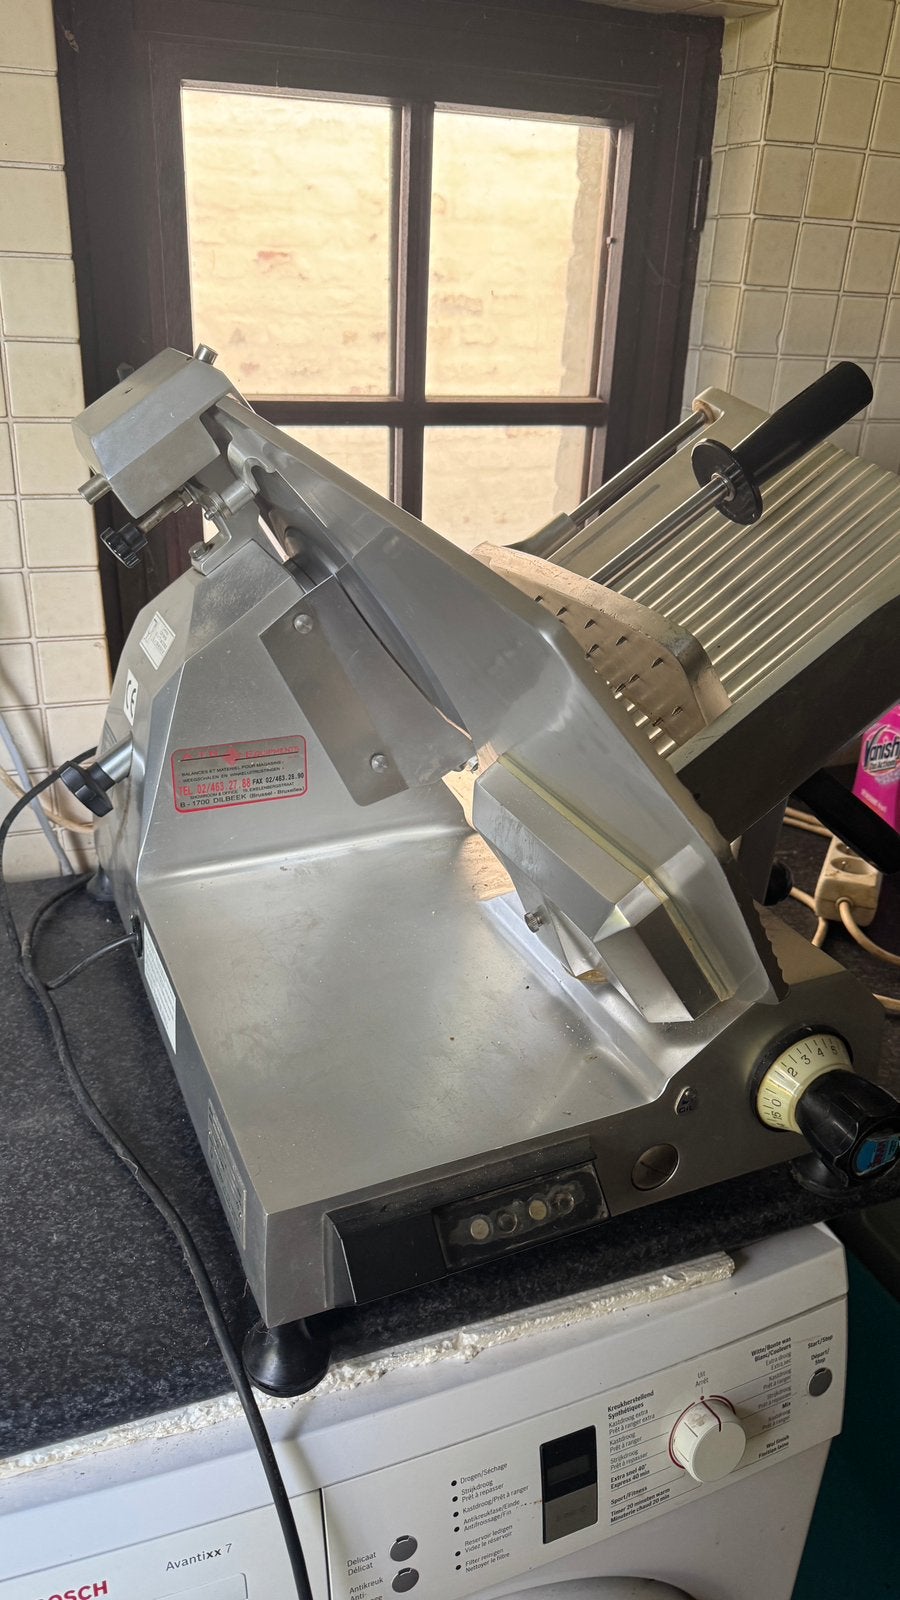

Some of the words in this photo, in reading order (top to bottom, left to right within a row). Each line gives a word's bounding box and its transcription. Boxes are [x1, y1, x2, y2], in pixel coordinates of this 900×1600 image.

[213, 794, 247, 804] DILBEEK
[771, 1098, 782, 1107] 0
[787, 1067, 798, 1078] 2
[800, 1055, 811, 1065] 3
[817, 1047, 825, 1057] 4
[751, 1341, 781, 1356] Witte/Bonte
[807, 1335, 833, 1349] Start/Stop
[754, 1344, 791, 1361] Blanc/Couleurs
[815, 1357, 826, 1365] Stop
[608, 1390, 654, 1412] Kreukherstellend
[608, 1402, 644, 1420] Synthétiques
[609, 1414, 635, 1428] Kastdroog
[635, 1409, 648, 1418] extra
[609, 1426, 620, 1434] Prêt
[625, 1418, 642, 1430] ranger
[642, 1414, 655, 1422] extra
[610, 1432, 636, 1446] Kastdroog
[610, 1444, 621, 1453] Prêt
[626, 1436, 642, 1447] ranger
[610, 1449, 639, 1464] Strijkdroog
[610, 1462, 622, 1470] Prêt
[626, 1452, 648, 1464] repasser
[460, 1463, 508, 1484] Drogen/Séchage
[611, 1473, 626, 1483] Extra
[626, 1468, 637, 1476] snel
[461, 1480, 493, 1496] Strijkdroog
[611, 1478, 631, 1489] Express
[462, 1494, 474, 1503] Prêt
[480, 1483, 504, 1496] repasser
[463, 1493, 505, 1514] Kastdroog/Prêt
[511, 1485, 529, 1496] ranger
[611, 1486, 647, 1505] Sport/Fitness
[611, 1507, 626, 1516] Timer
[634, 1496, 655, 1506] minuten
[656, 1488, 670, 1497] warm
[464, 1500, 520, 1525] Antikreukfase/Einde
[464, 1510, 512, 1532] Antifroissage/Fin
[611, 1509, 636, 1523] Minuterie
[636, 1501, 652, 1511] chaud
[465, 1532, 491, 1546] Reservoir
[492, 1525, 513, 1537] ledigen
[465, 1544, 480, 1553] Videz
[488, 1532, 512, 1544] réservoir
[166, 1548, 223, 1571] Avantixx
[225, 1543, 234, 1554] 7
[347, 1552, 377, 1568] Delicaat
[465, 1557, 480, 1567] Filter
[481, 1549, 504, 1560] reinigen
[466, 1560, 489, 1573] Nettoyer
[497, 1552, 510, 1561] filtre
[348, 1562, 373, 1577] Délicat
[350, 1577, 384, 1595] Antikreuk
